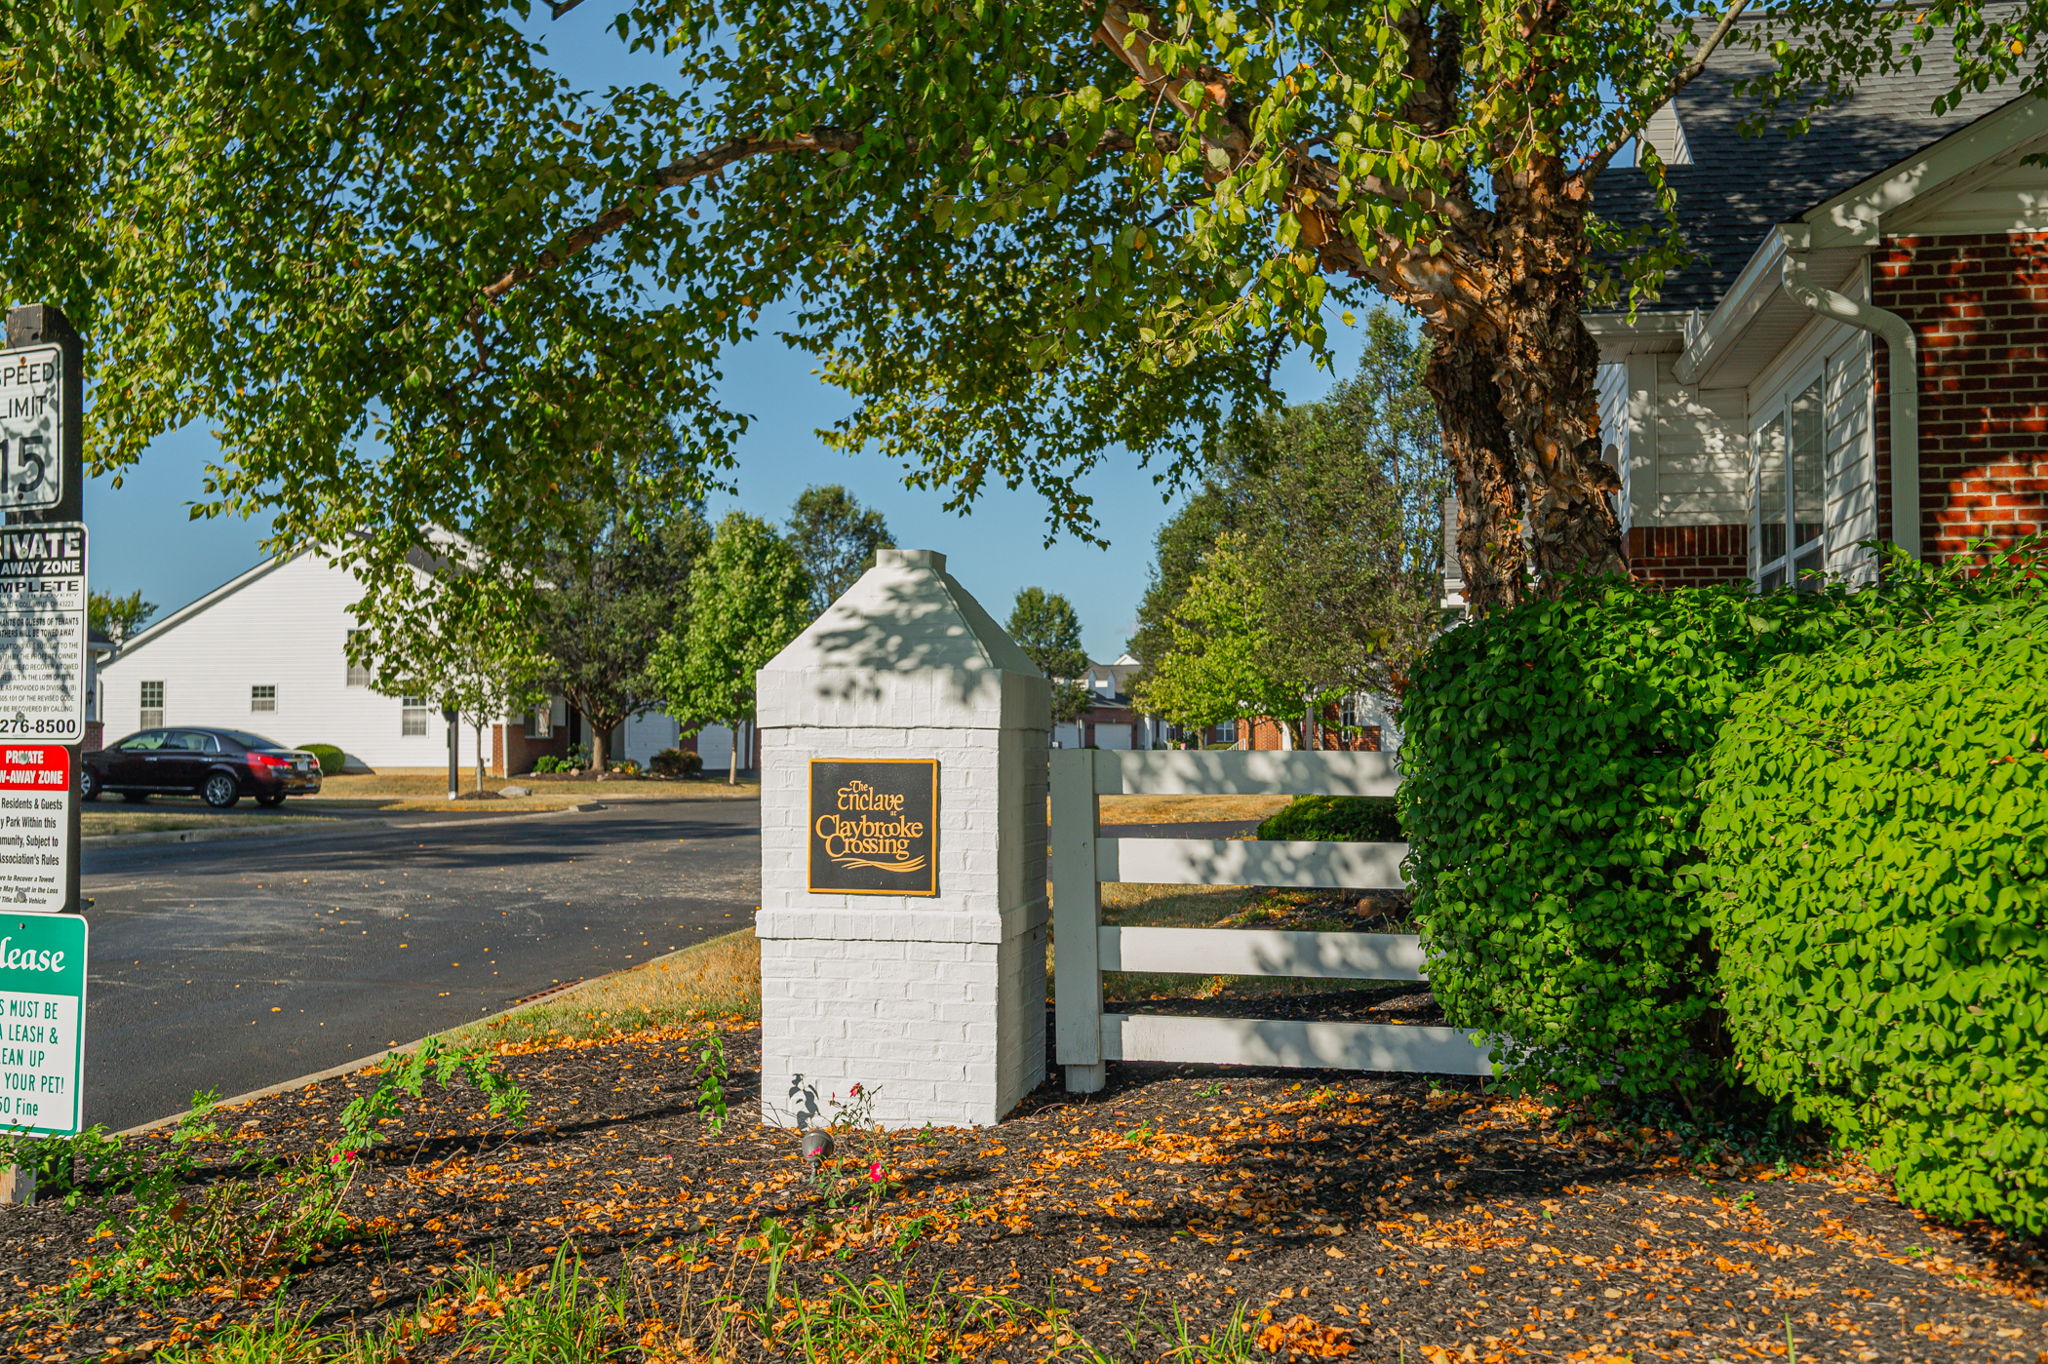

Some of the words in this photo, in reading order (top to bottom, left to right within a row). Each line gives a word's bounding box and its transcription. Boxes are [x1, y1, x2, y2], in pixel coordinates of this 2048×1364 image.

[0, 362, 55, 388] PEED
[0, 435, 45, 493] 15
[0, 531, 80, 560] IVATE
[1, 561, 40, 576] AWAY
[42, 560, 81, 575] ZONE
[55, 617, 79, 626] TENANTS
[41, 628, 58, 637] TOWED
[60, 628, 75, 637] AWAY
[38, 770, 64, 785] ZONE
[849, 780, 869, 793] The
[1, 797, 33, 810] Residents
[34, 798, 40, 810] &
[41, 798, 63, 810] Guests
[837, 786, 905, 811] Enclave
[6, 816, 21, 828] Park
[22, 816, 43, 828] Within
[44, 817, 57, 829] this
[815, 814, 924, 840] Claybrooke
[26, 834, 51, 849] Subject
[52, 836, 59, 847] to
[825, 833, 911, 861] Crossing
[41, 853, 60, 866] Rules
[7, 874, 13, 882] to
[13, 874, 34, 882] Recover
[39, 875, 55, 883] Towed
[3, 885, 14, 893] May
[47, 887, 59, 895] Loss
[29, 897, 47, 905] Vehicle
[10, 999, 40, 1019] MUST
[44, 1001, 59, 1020] BE
[9, 1022, 44, 1044] LEASH
[49, 1026, 59, 1045] &
[0, 1047, 24, 1066] EAN
[29, 1049, 45, 1068] UP
[4, 1071, 36, 1092] YOUR
[41, 1074, 65, 1095] PET!
[16, 1097, 39, 1116] Fine
